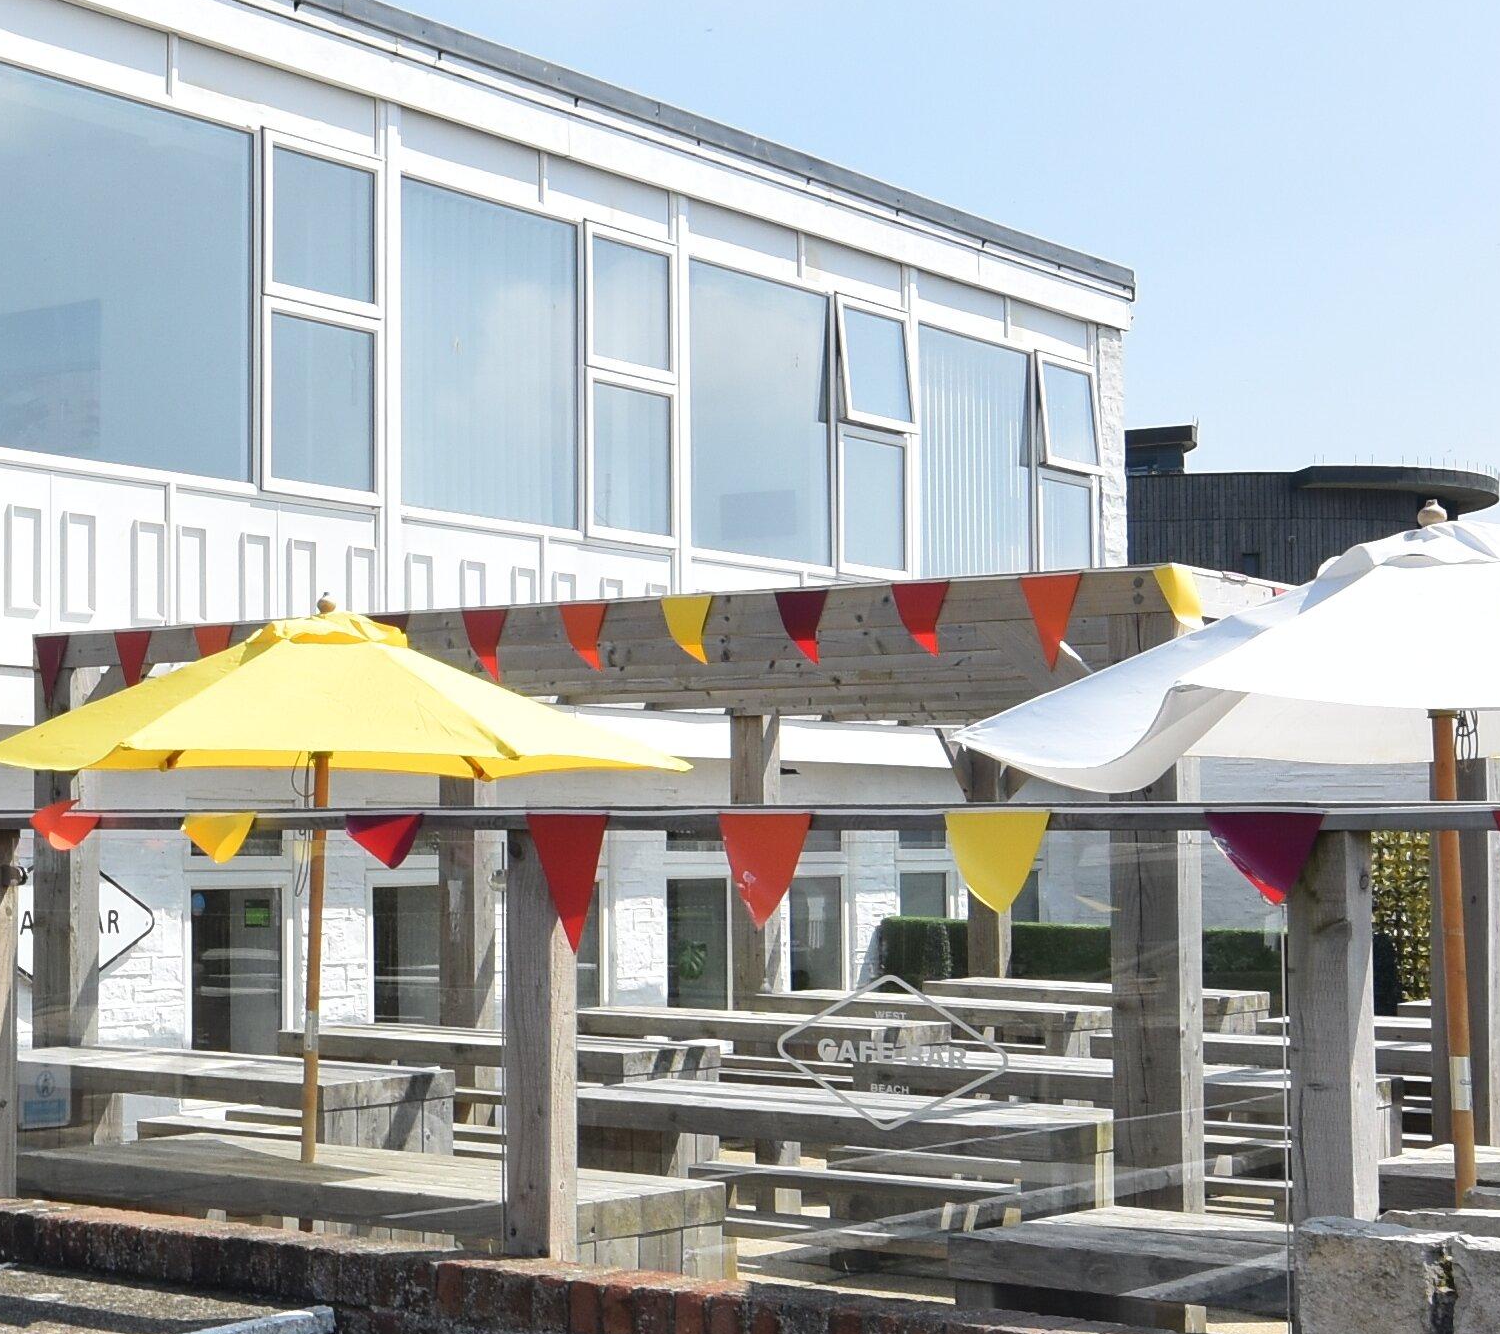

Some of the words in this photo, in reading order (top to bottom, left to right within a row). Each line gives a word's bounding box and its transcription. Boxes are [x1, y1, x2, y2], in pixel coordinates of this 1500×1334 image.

[875, 1010, 907, 1020] WEST
[817, 1038, 895, 1064] CAFE
[870, 1083, 910, 1095] BEACH
